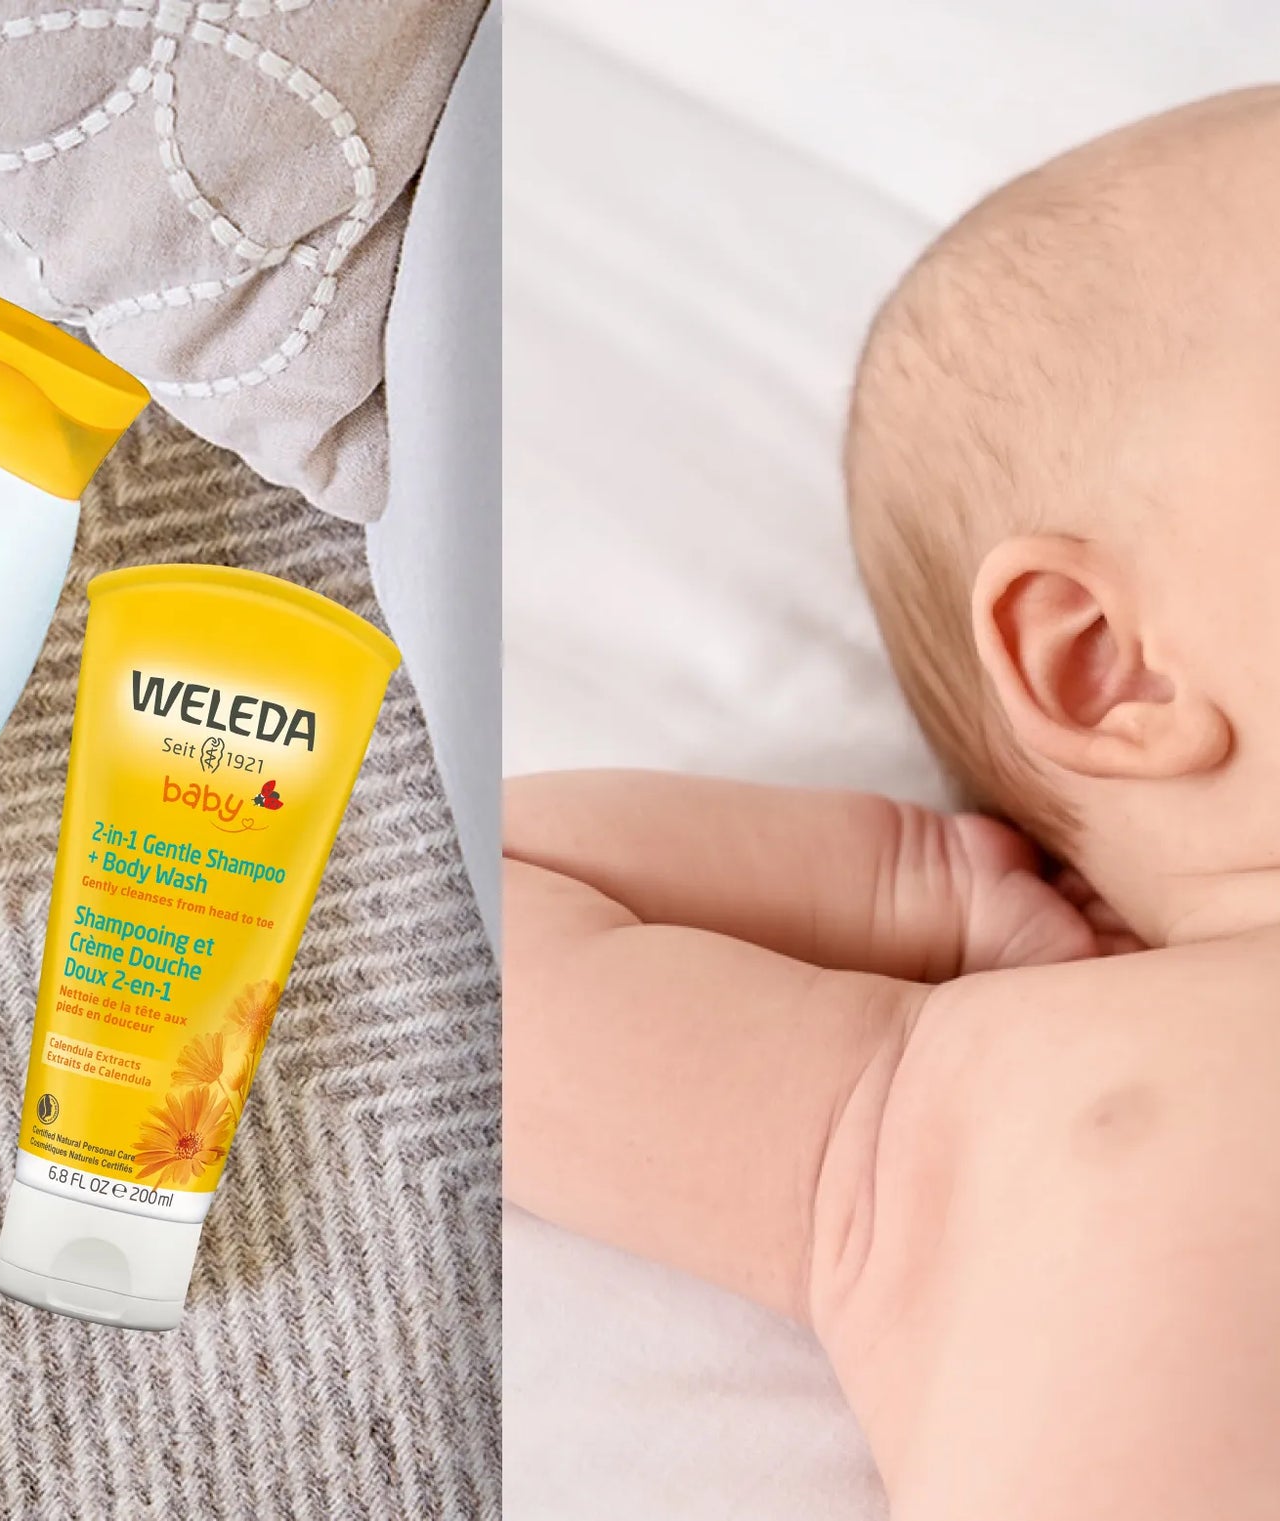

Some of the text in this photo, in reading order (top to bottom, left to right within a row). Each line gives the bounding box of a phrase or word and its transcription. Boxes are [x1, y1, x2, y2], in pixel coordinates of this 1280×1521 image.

[132, 669, 316, 753] WELEDA
[161, 737, 264, 775] Seit 1921
[162, 774, 245, 823] baby
[88, 850, 208, 895] + Body Wash
[91, 821, 286, 884] 2-in-1 Gentle Shampoo
[81, 875, 275, 930] Gently cleanses from head to toe
[74, 904, 215, 957] Shampooing et
[69, 931, 202, 981] Crème Douche
[63, 956, 172, 1002] Doux 2-en-1
[55, 1000, 155, 1034] pieds en douceur
[59, 984, 188, 1027] Nettoie de la tête aux
[46, 1050, 152, 1088] Extraits de Calendula
[49, 1036, 142, 1071] Calendula Extracts
[55, 1133, 82, 1149] Natural
[81, 1140, 117, 1158] Personal
[117, 1150, 137, 1163] Care
[68, 1149, 100, 1166] Naturels
[100, 1158, 133, 1174] Certifiés
[48, 1165, 69, 1184] 6.8
[69, 1171, 86, 1190] FL
[89, 1177, 111, 1196] OZ
